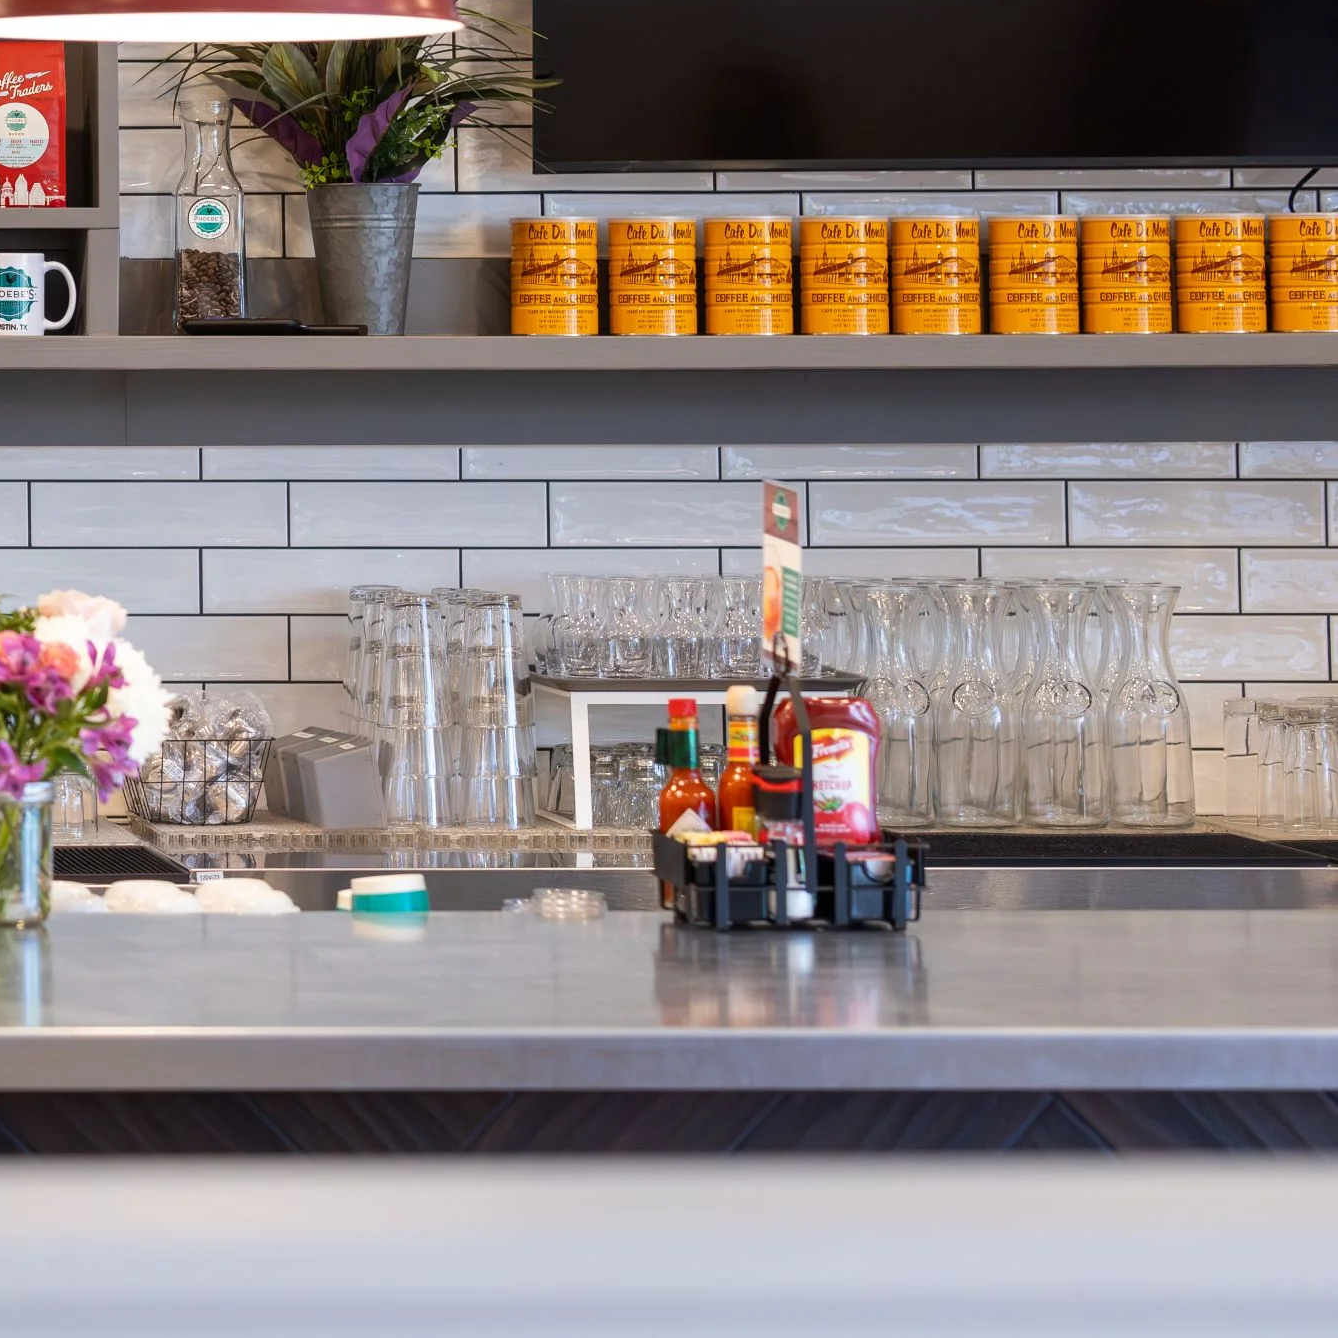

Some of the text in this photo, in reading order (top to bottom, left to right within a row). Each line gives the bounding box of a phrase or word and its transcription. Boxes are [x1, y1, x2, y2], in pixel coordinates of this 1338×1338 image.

[9, 81, 53, 99] Traders
[528, 223, 566, 240] Café Du
[626, 223, 666, 240] Café Du
[724, 223, 763, 240] Café Du
[821, 223, 860, 240] Café Du
[911, 222, 951, 239] Café Du
[1018, 222, 1039, 239] Café
[1110, 222, 1133, 239] Café
[1199, 222, 1221, 239] Café
[1299, 221, 1322, 238] Café
[520, 294, 551, 304] COFFEE
[618, 294, 651, 304] COFFEE
[715, 294, 765, 304] COFFEE AND
[811, 294, 862, 304] COFFEE AND
[903, 293, 953, 303] COFFEE AND
[1007, 293, 1043, 303] COFFEE
[1100, 293, 1136, 303] COFFEE
[1189, 293, 1224, 303] COFFEE
[1288, 291, 1325, 302] COFFEE
